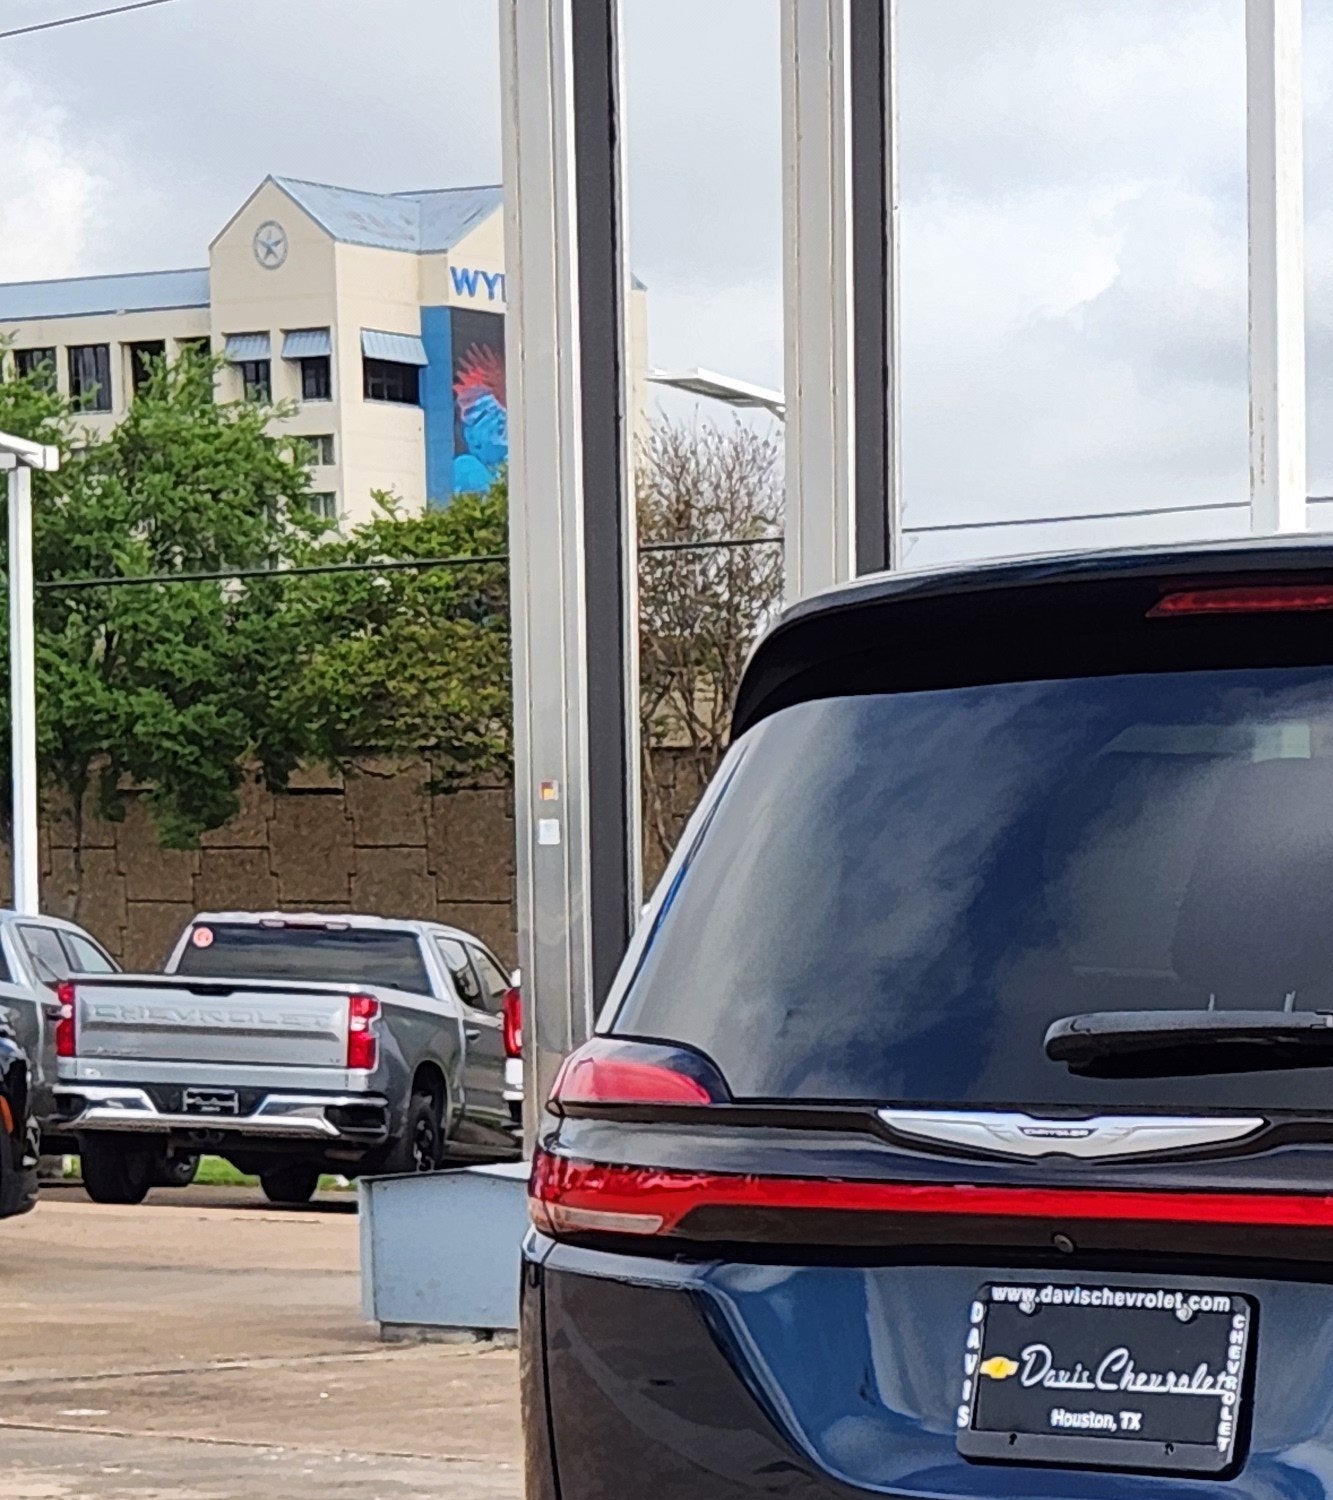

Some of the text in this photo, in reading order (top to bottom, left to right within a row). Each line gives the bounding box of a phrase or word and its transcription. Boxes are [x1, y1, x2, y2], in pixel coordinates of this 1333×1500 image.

[991, 1285, 1231, 1312] www.davischevrolet.com
[957, 1301, 985, 1428] DAVIS
[1021, 1344, 1228, 1395] Davis Chevrolet
[1216, 1313, 1246, 1452] CHEVROLET
[1050, 1408, 1143, 1432] Houston, TX
